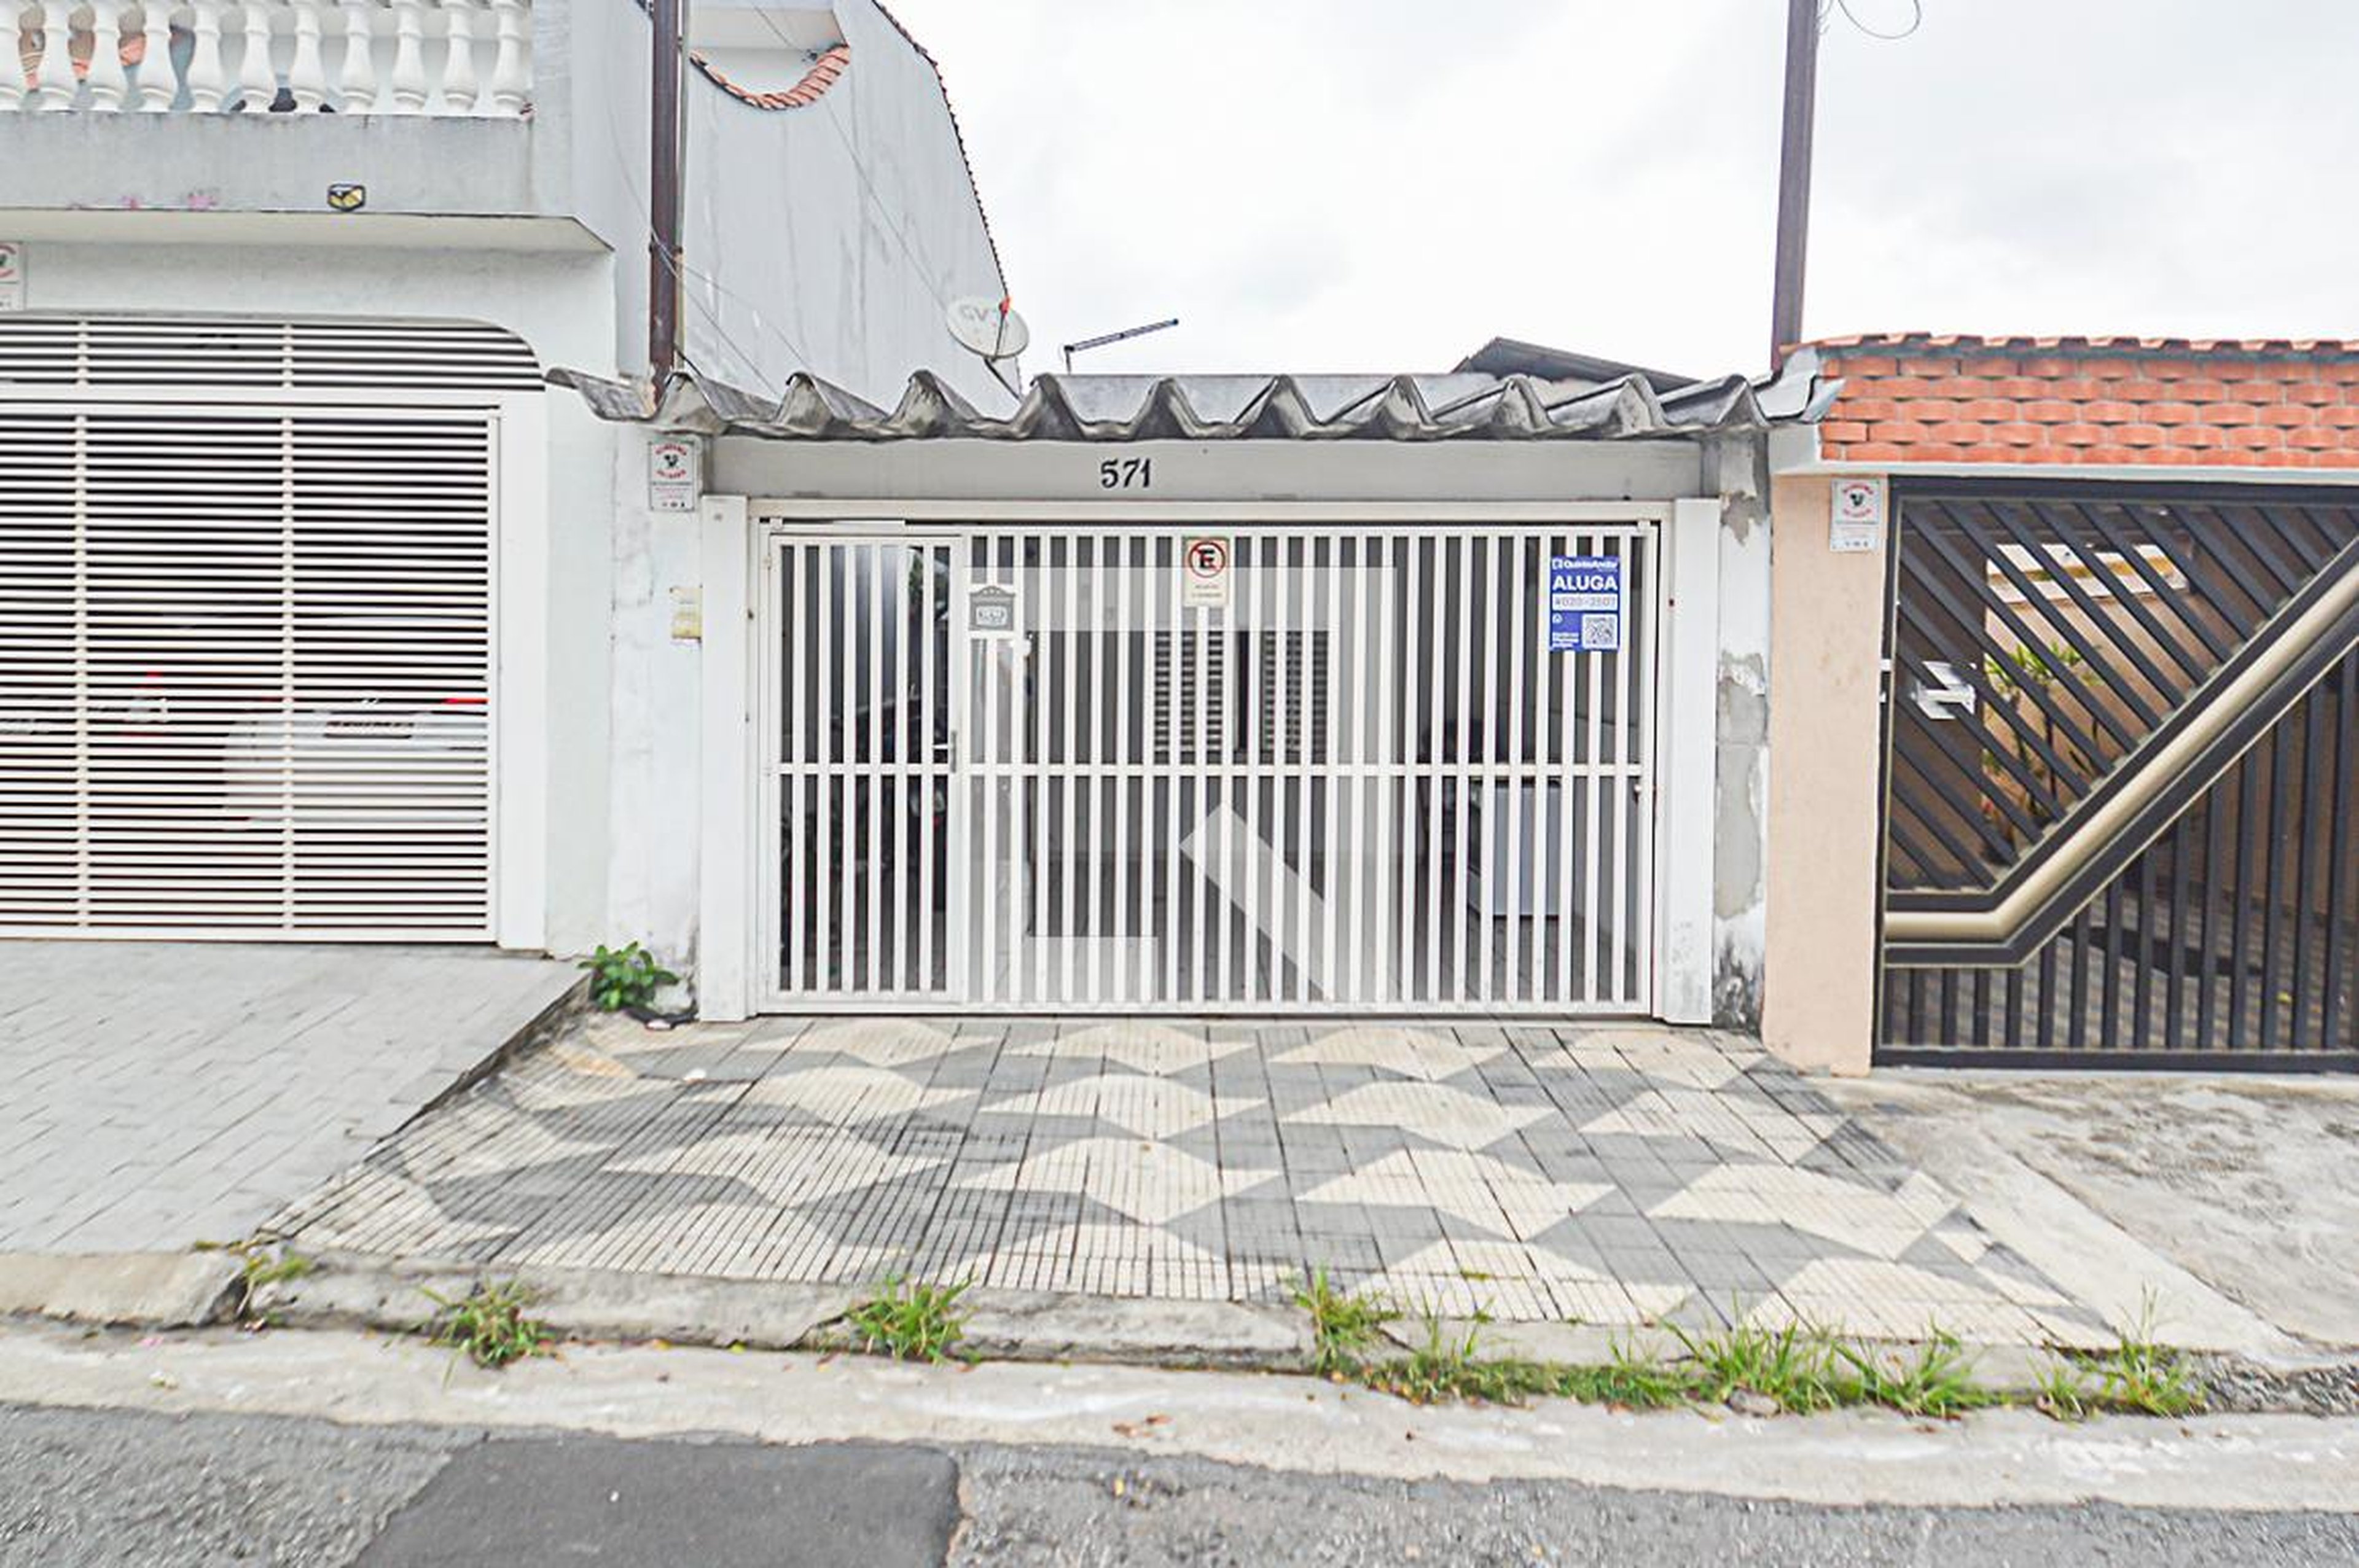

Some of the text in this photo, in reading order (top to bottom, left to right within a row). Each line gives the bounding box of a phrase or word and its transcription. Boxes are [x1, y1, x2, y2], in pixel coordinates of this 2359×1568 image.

[1101, 458, 1151, 488] 571
[1199, 548, 1216, 569] E
[1552, 575, 1618, 591] ALUGA
